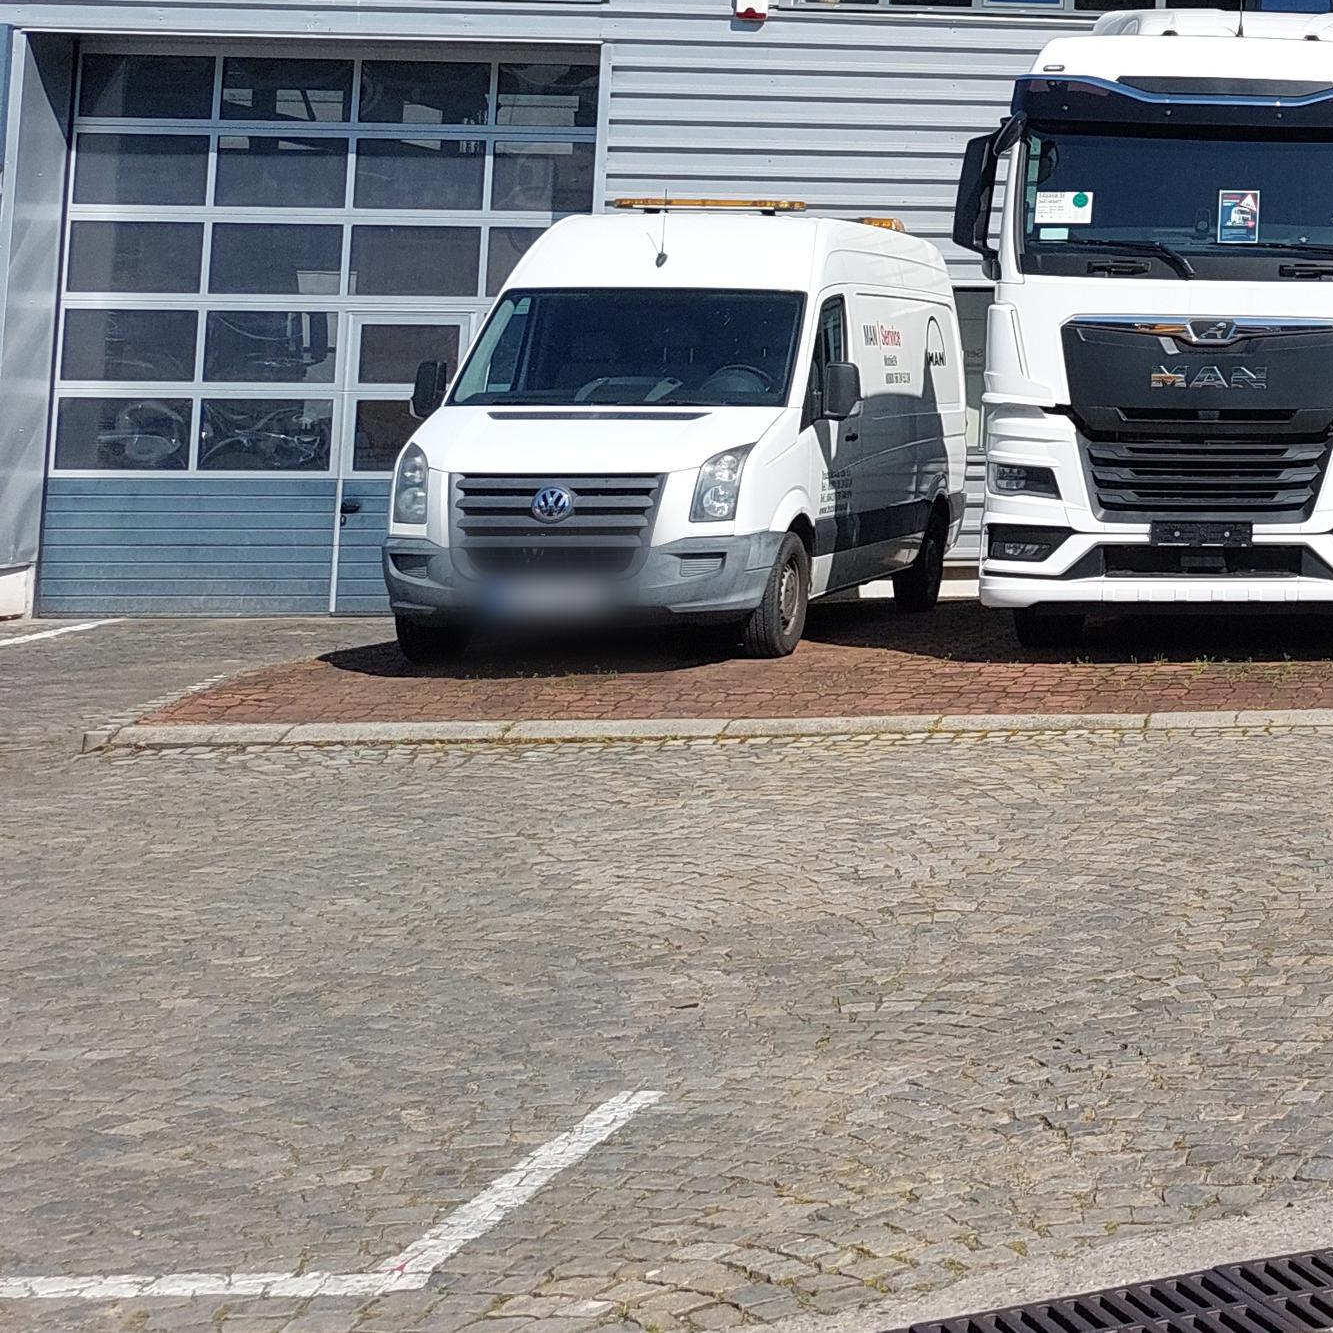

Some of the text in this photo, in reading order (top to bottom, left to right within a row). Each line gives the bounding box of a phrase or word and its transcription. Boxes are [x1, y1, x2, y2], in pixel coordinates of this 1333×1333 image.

[863, 324, 901, 347] MAN Service
[928, 351, 945, 366] MAN
[1150, 365, 1268, 388] MAN
